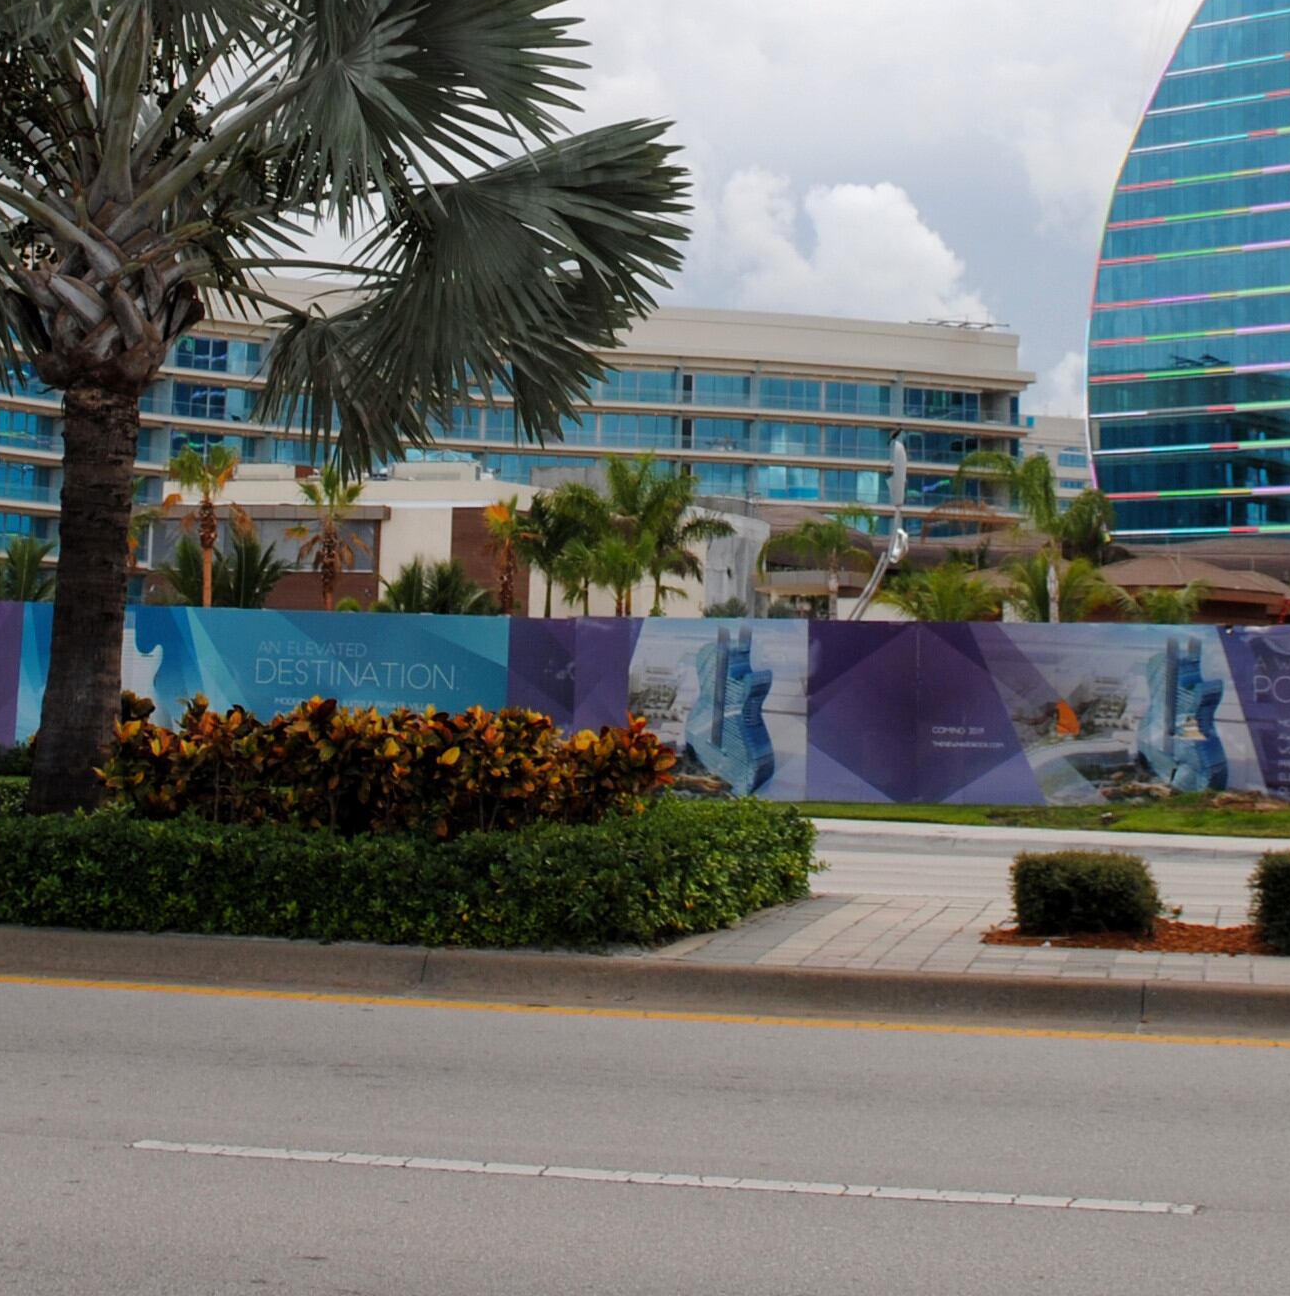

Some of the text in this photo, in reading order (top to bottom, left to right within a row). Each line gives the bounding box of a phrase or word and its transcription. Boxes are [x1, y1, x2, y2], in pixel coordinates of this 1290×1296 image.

[257, 640, 368, 658] AN ELEVATED
[1253, 657, 1267, 672] A
[931, 726, 966, 736] COMING
